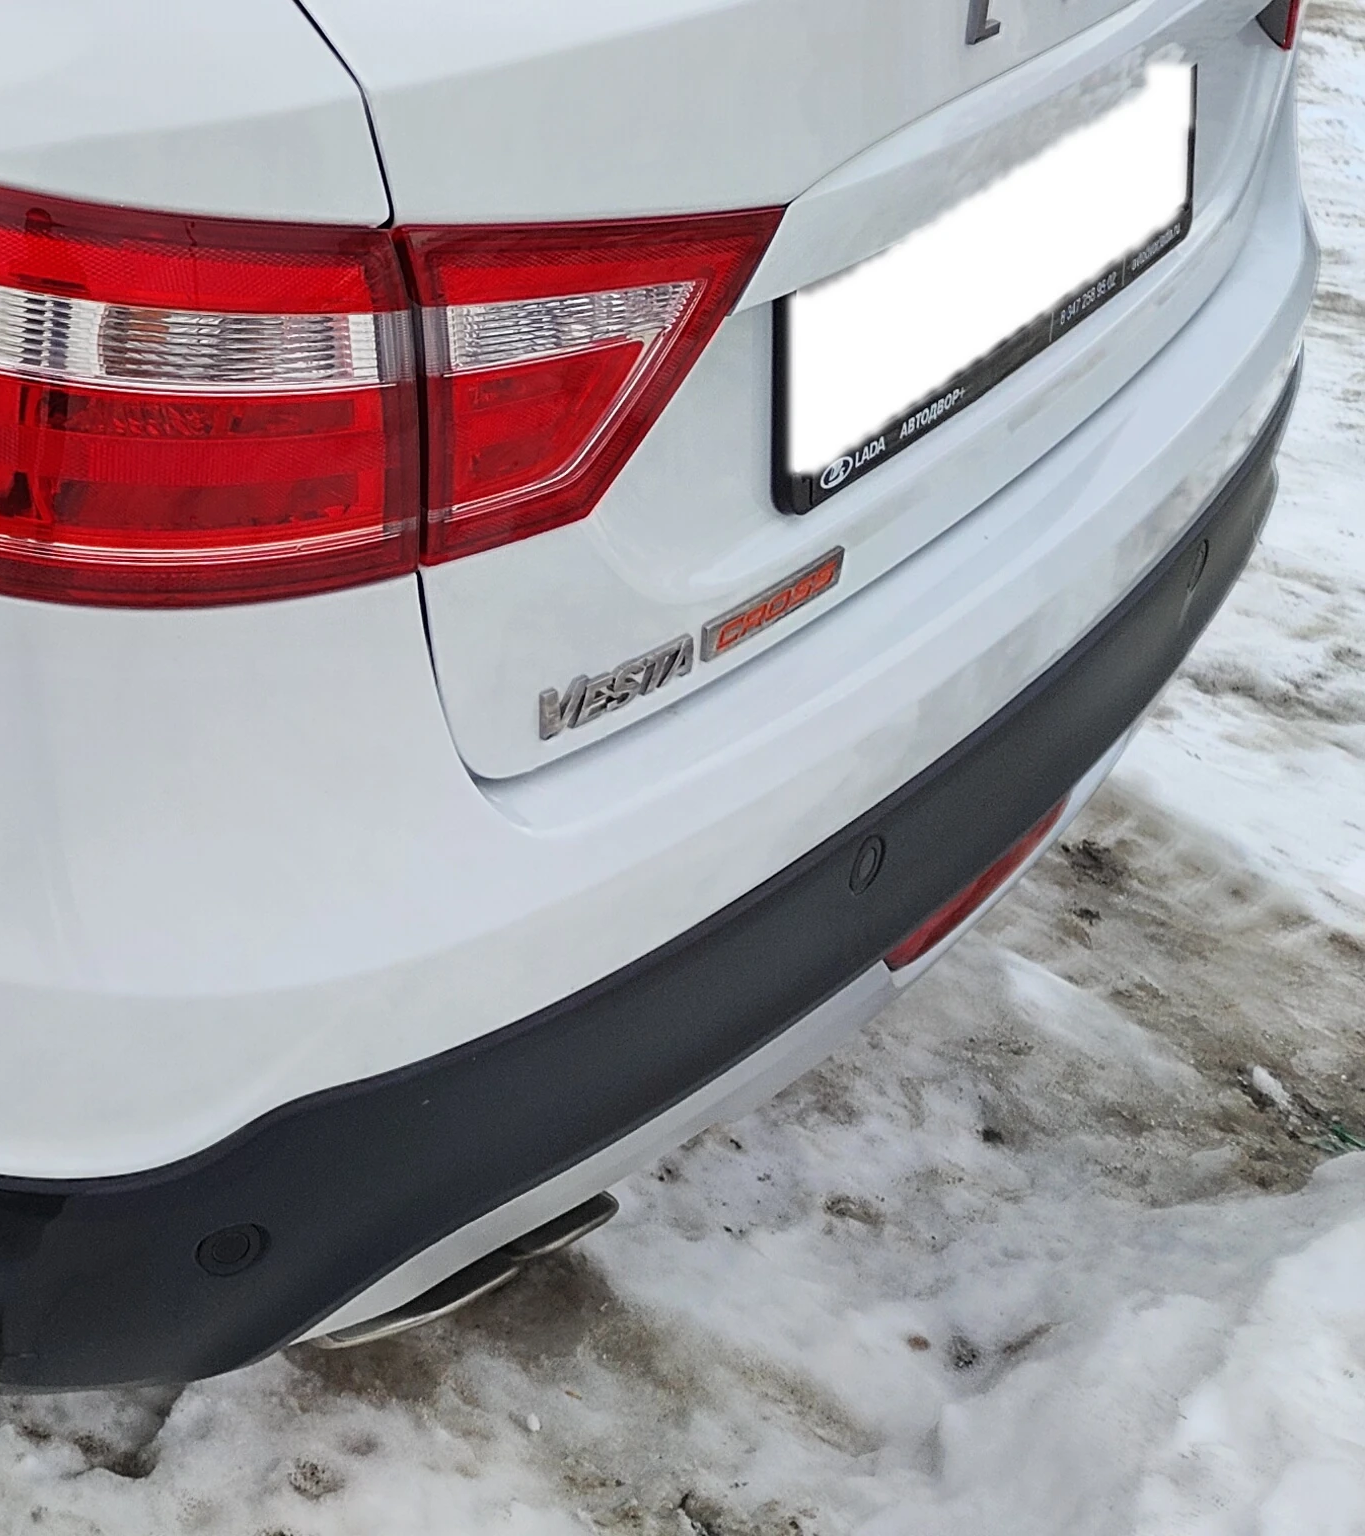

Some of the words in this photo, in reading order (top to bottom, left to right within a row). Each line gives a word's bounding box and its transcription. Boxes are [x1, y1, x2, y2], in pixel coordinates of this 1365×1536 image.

[855, 436, 886, 469] LADA
[538, 632, 694, 741] VESTA
[715, 559, 839, 651] CROSS
